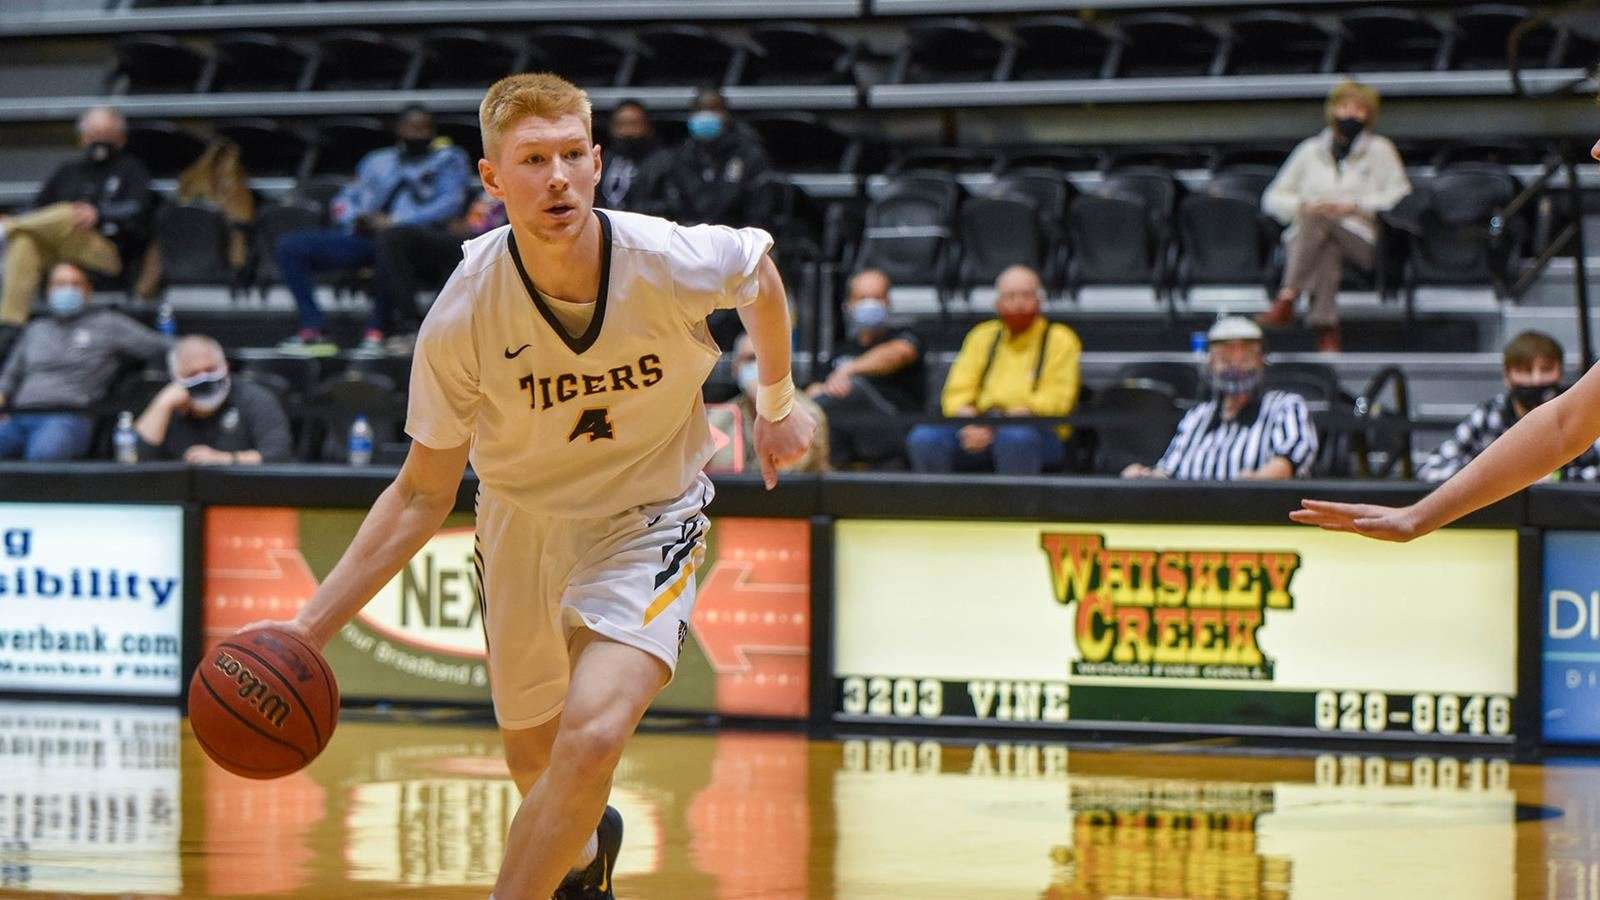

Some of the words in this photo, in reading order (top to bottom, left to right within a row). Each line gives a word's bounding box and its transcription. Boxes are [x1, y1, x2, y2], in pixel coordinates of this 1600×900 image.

[519, 354, 663, 410] TIGERS
[567, 407, 615, 443] 4
[1040, 532, 1301, 609] WHISKEY
[1074, 593, 1266, 664] CREEK
[214, 651, 292, 728] Wilson
[843, 677, 943, 717] 3203
[967, 681, 1070, 722] VINE
